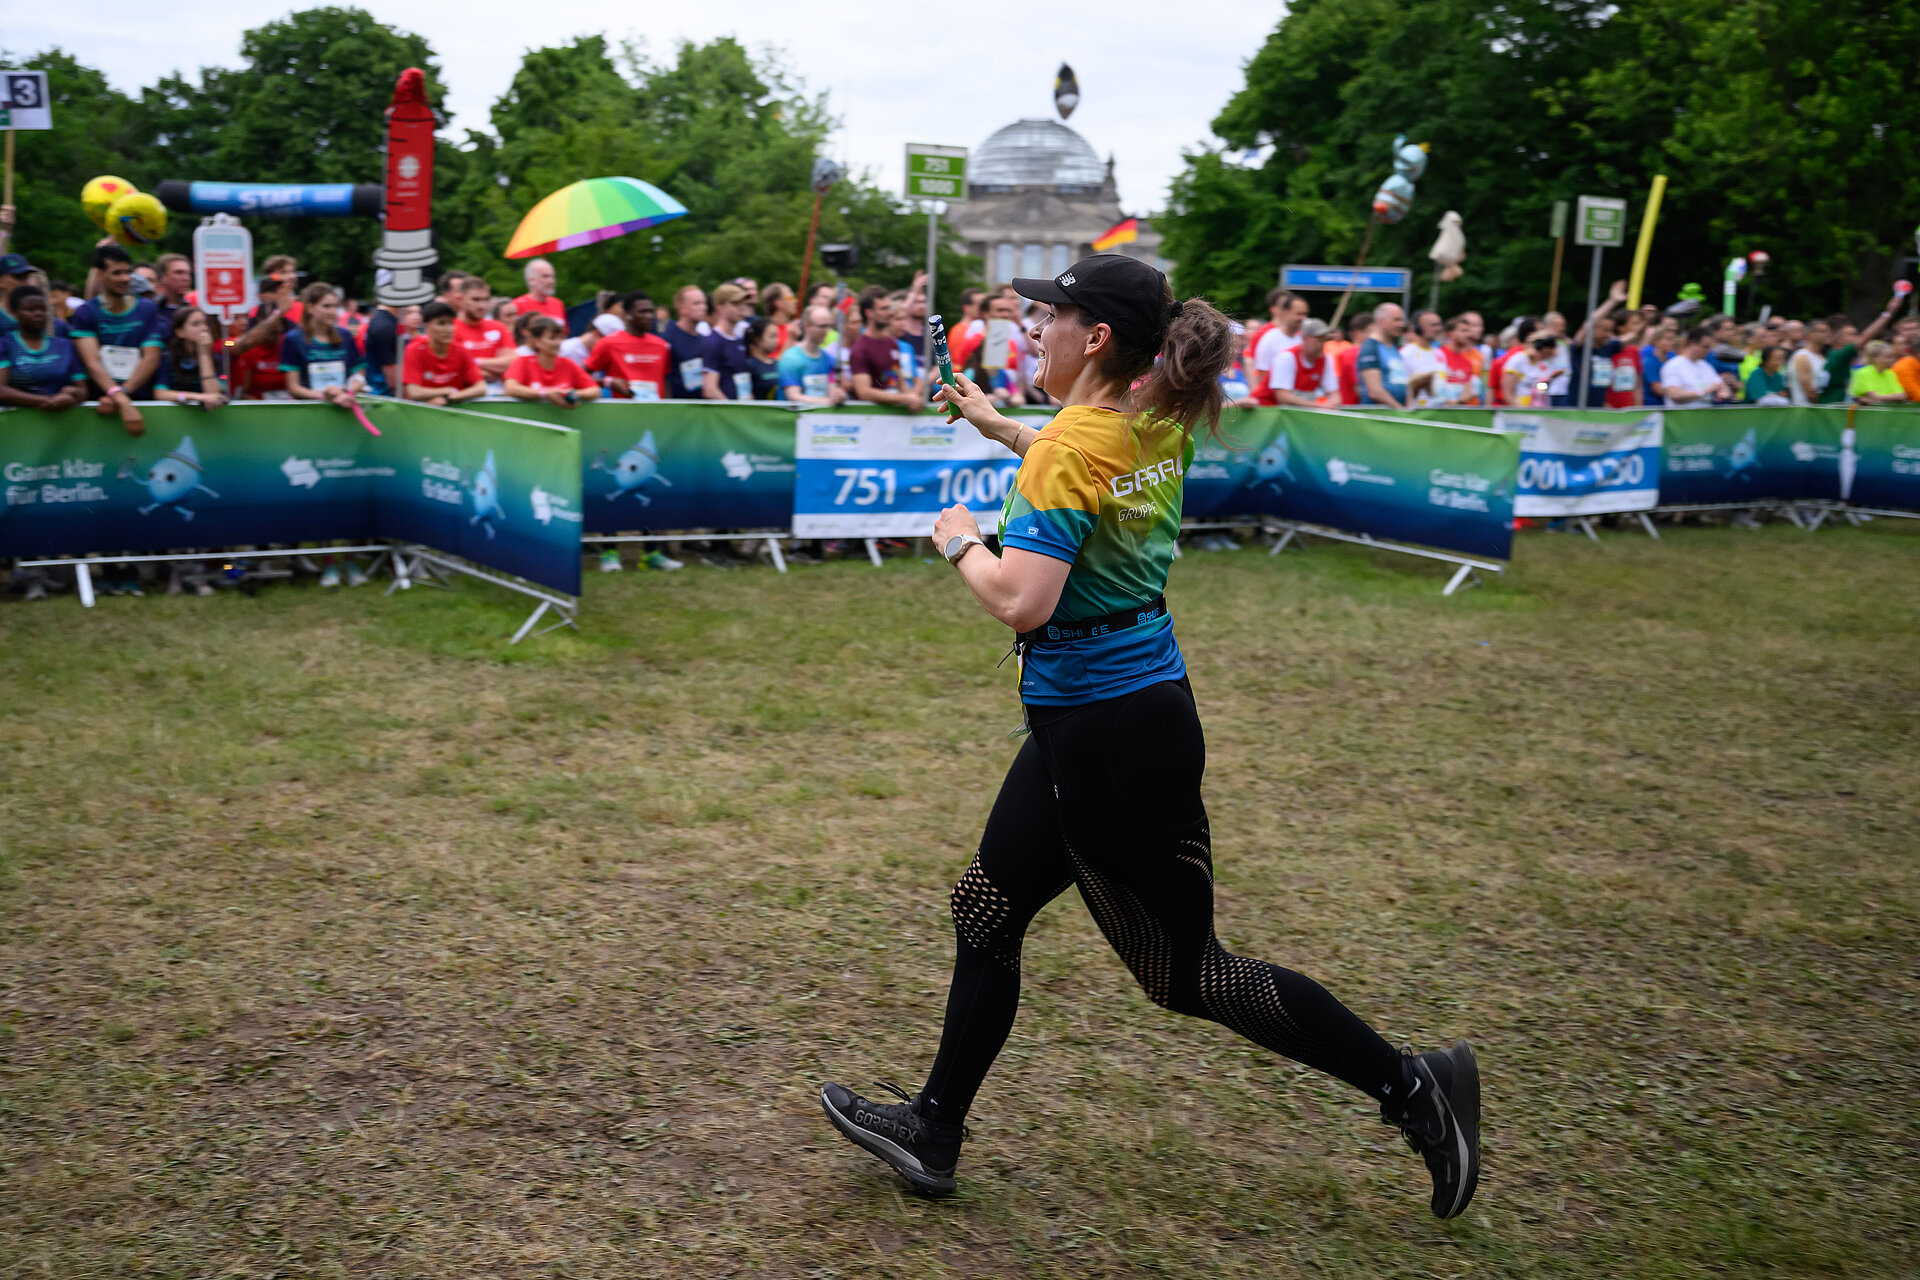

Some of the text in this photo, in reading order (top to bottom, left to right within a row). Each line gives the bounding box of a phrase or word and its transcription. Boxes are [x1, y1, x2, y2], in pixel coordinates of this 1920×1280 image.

[13, 79, 38, 106] 3
[4, 462, 61, 482] Ganz
[833, 467, 897, 506] 751
[937, 466, 1019, 504] 1000
[1118, 501, 1158, 522] GRUPPE
